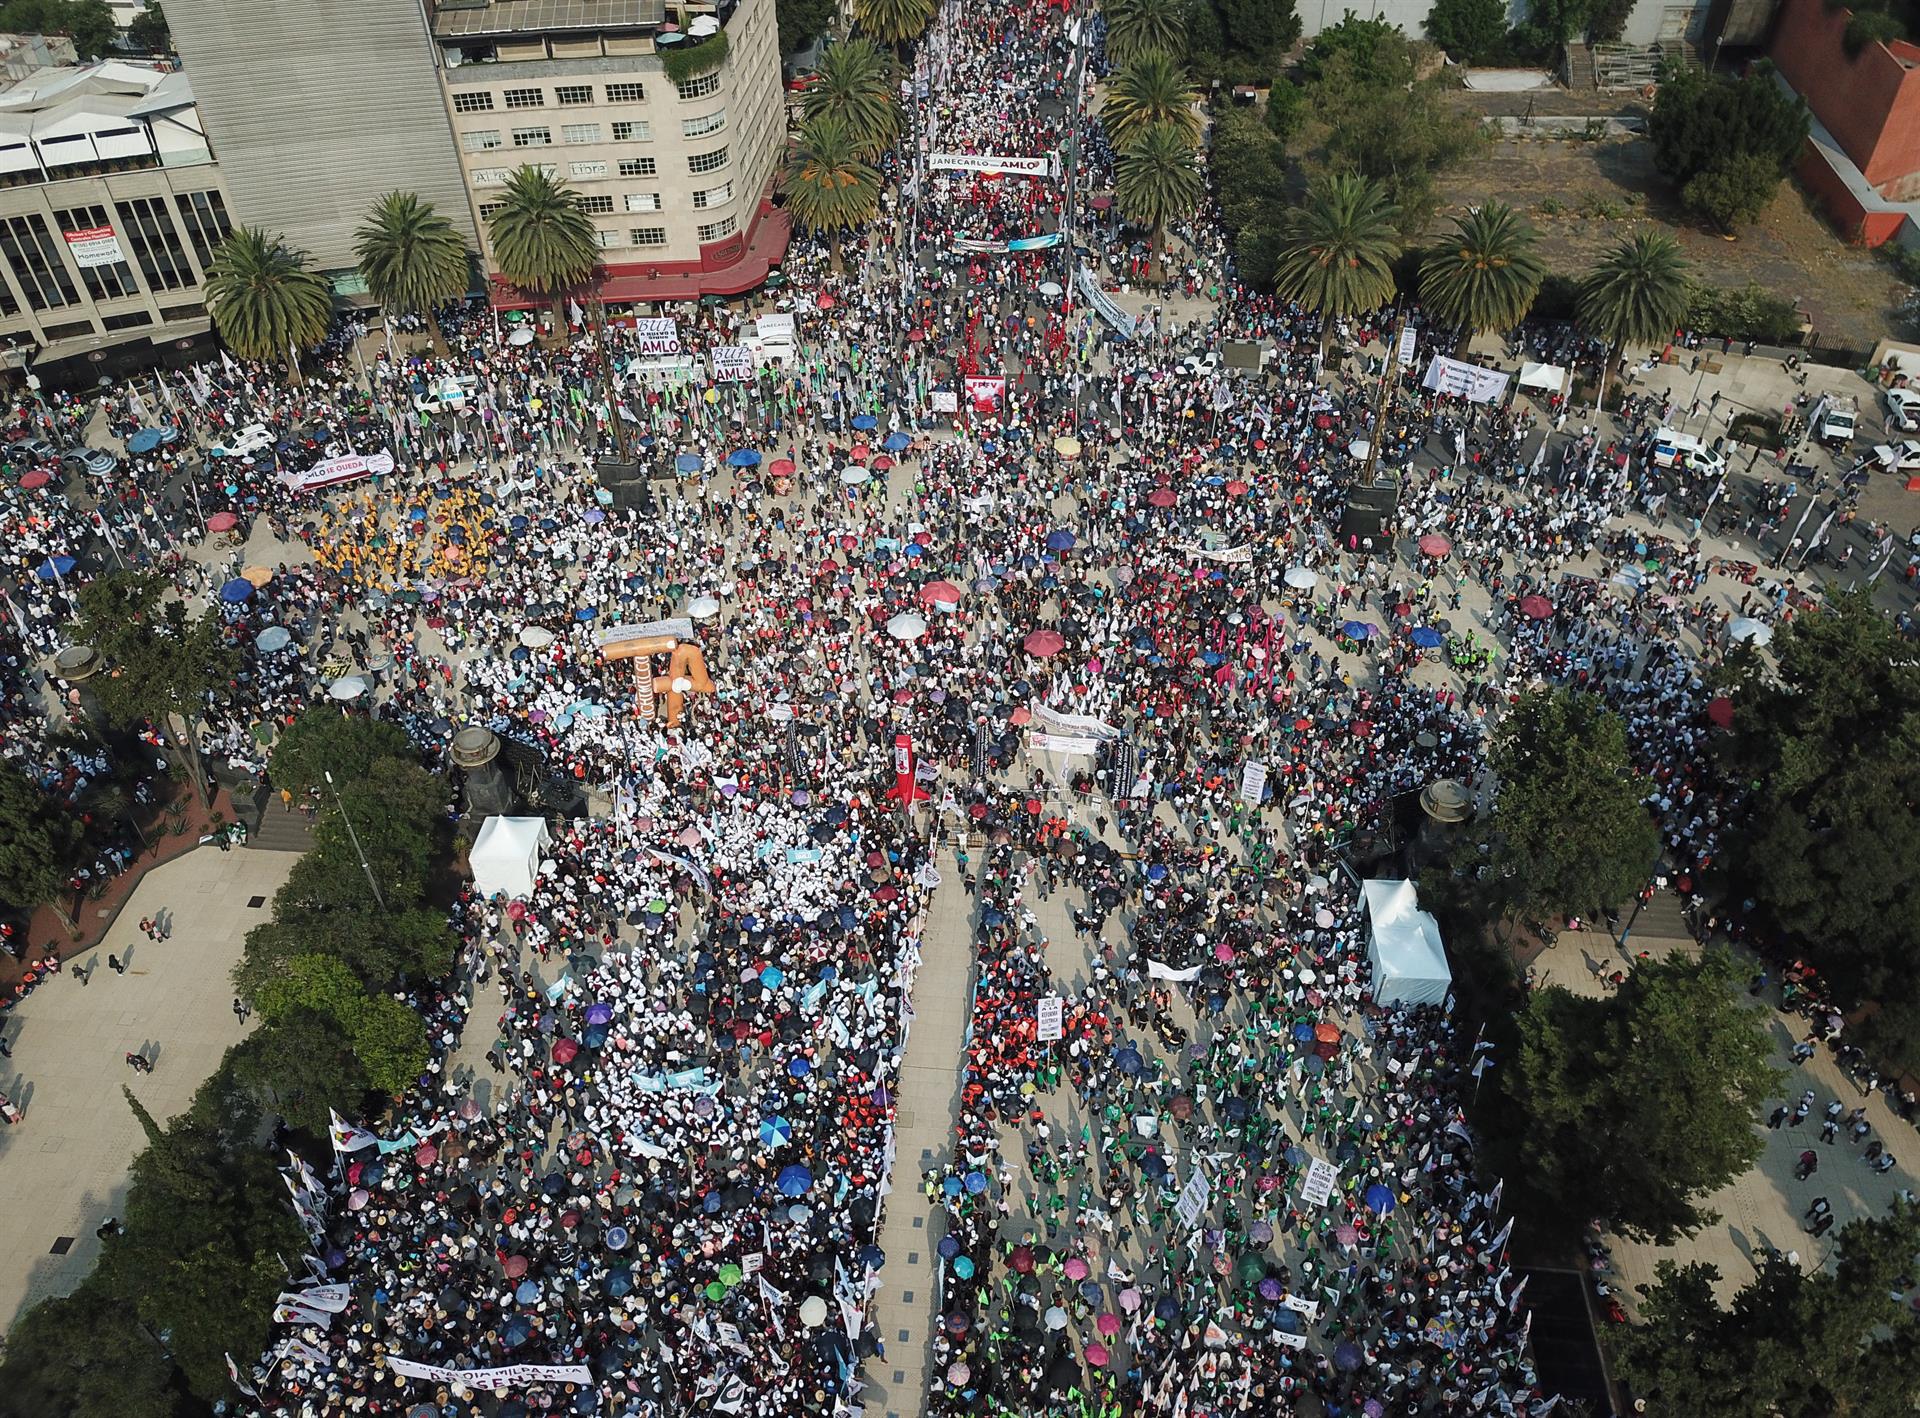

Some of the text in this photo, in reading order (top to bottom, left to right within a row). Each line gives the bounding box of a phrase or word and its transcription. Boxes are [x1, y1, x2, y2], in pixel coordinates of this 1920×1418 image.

[571, 164, 606, 176] Libre
[932, 158, 989, 167] JANECARLO
[1000, 161, 1036, 170] AMLO
[78, 248, 118, 259] Homework
[642, 340, 679, 353] AMLO
[716, 368, 752, 380] AMLO
[326, 466, 335, 475] SE
[336, 461, 364, 472] QUEDA
[1227, 552, 1251, 562] AMLO
[634, 656, 656, 720] OCHIMILCO
[1312, 1172, 1330, 1183] REFORMA
[496, 1367, 538, 1377] MILPA
